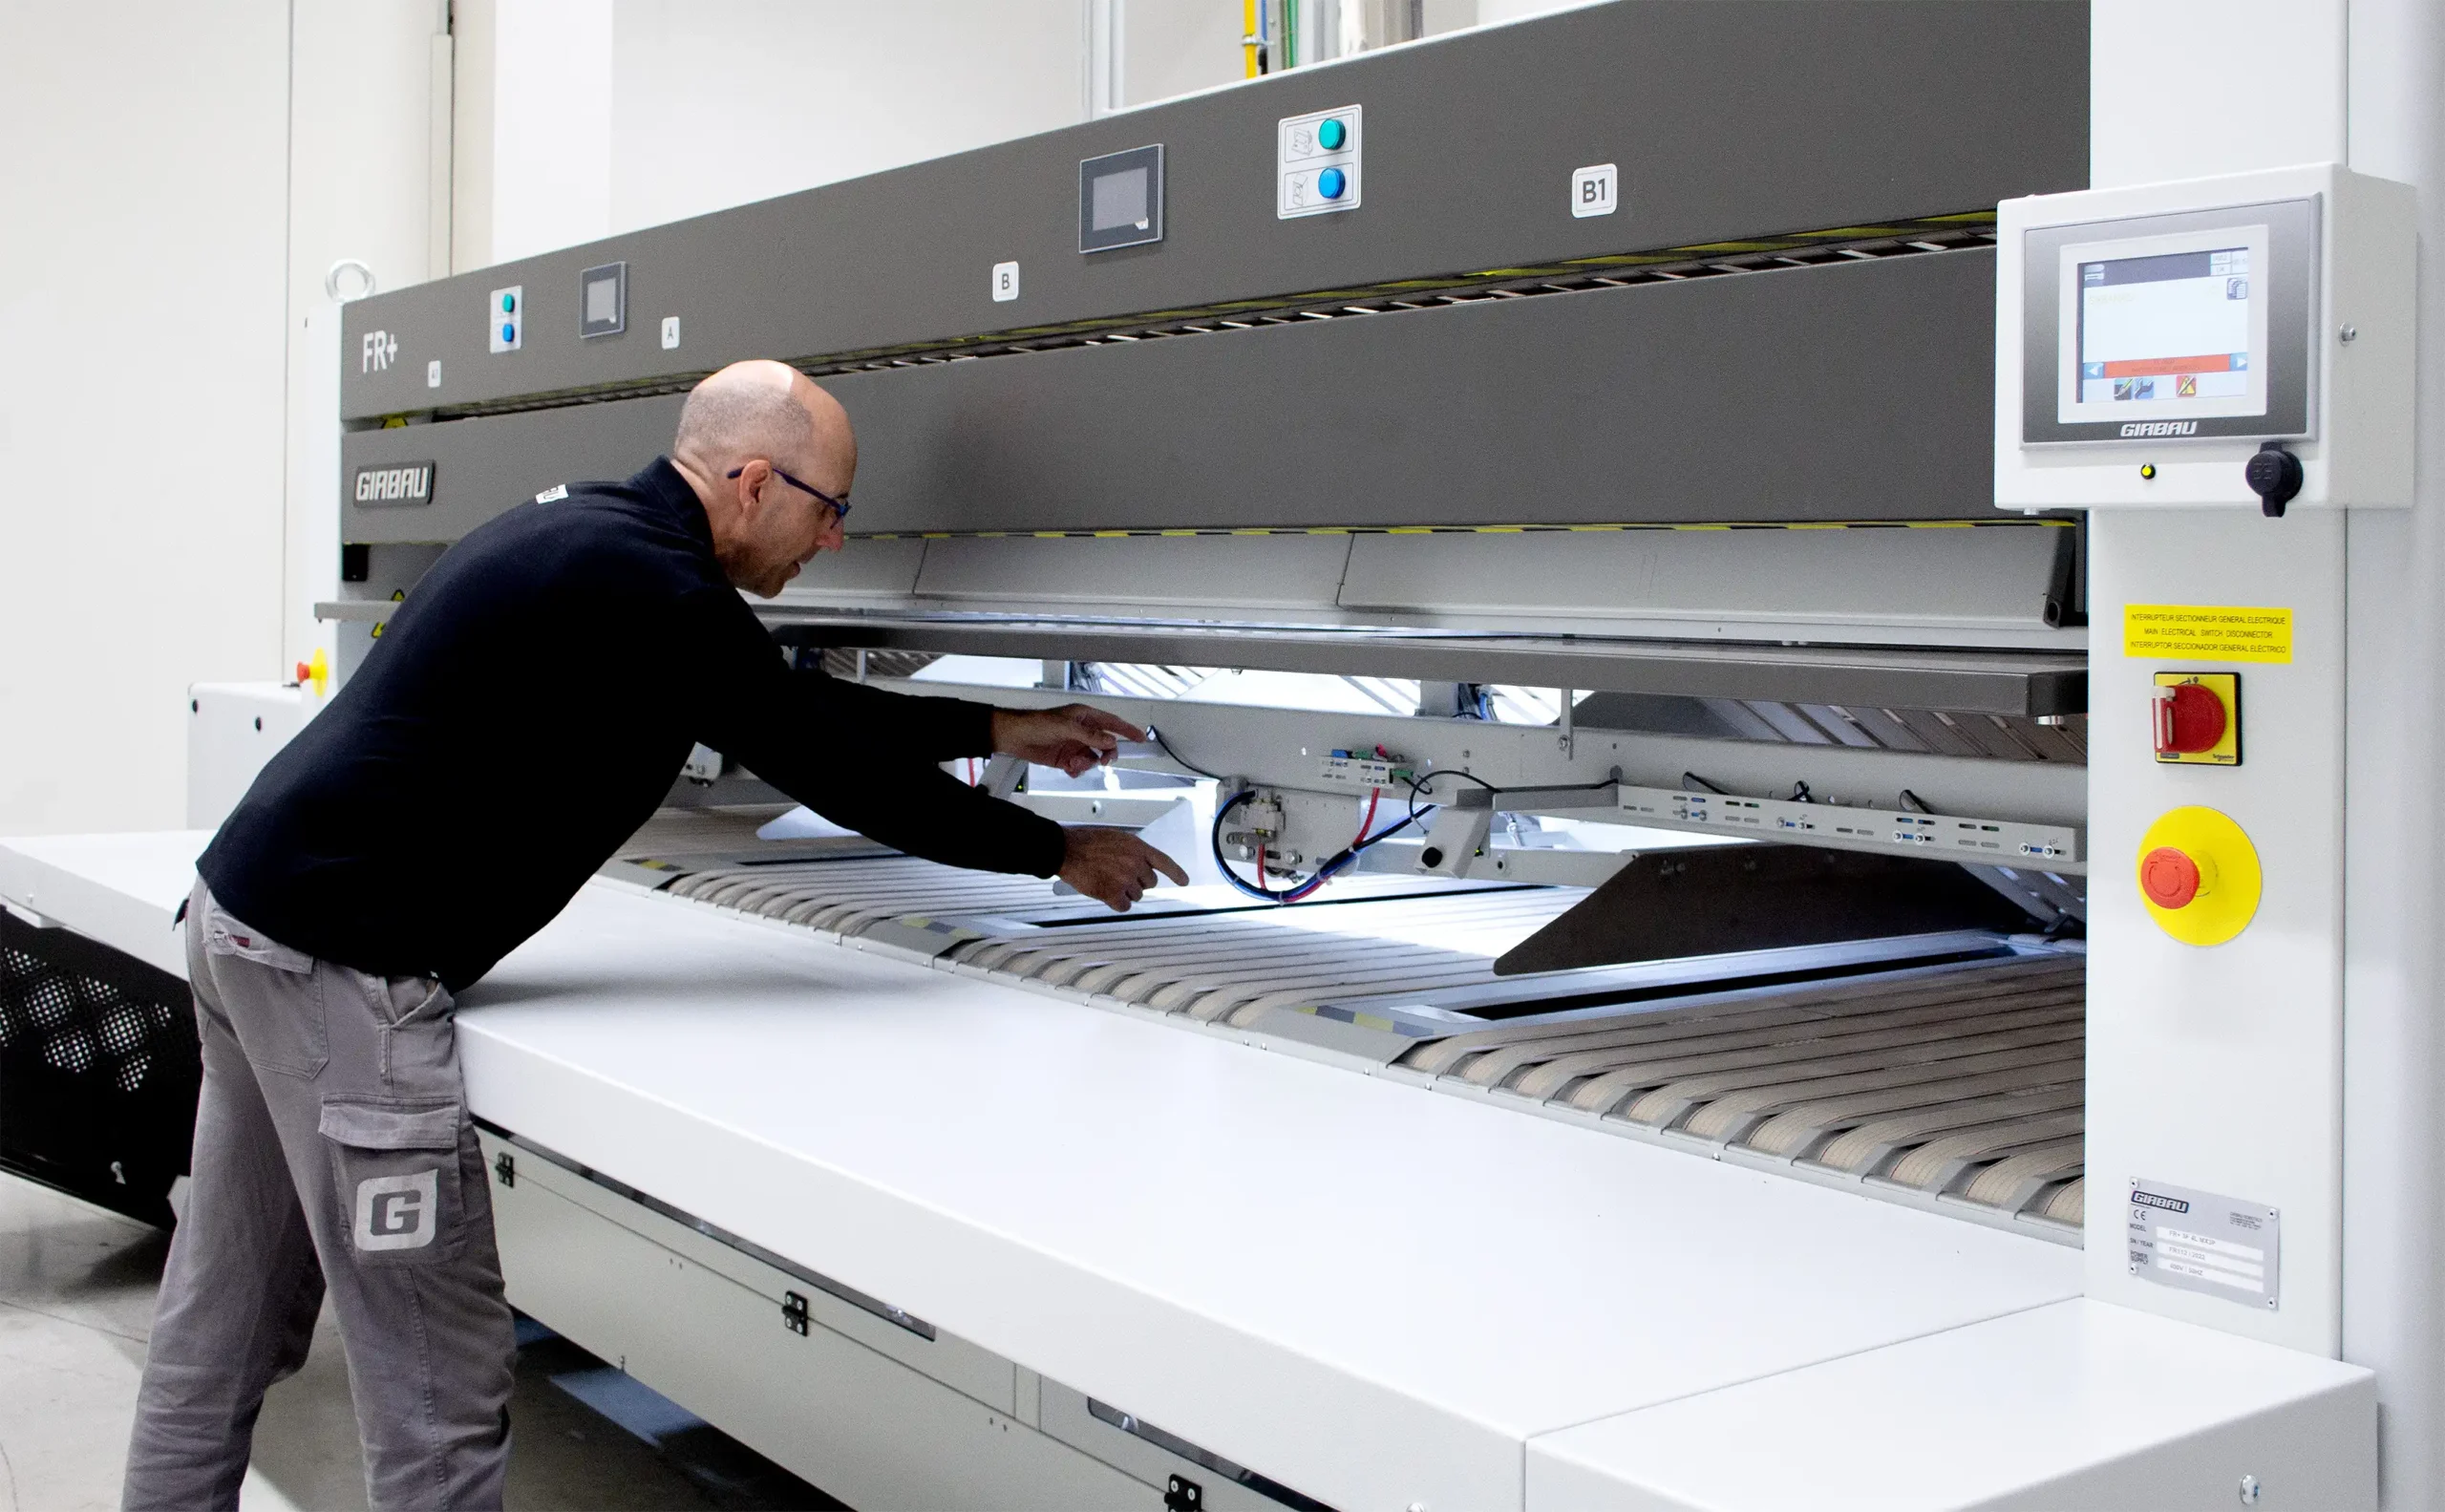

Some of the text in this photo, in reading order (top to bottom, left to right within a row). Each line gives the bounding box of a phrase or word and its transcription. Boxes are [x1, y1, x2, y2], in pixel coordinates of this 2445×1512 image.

[1583, 178, 1605, 203] B1
[1002, 273, 1010, 290] B
[667, 326, 674, 340] A
[363, 330, 398, 374] FR+
[2120, 420, 2198, 437] GIRBAU
[355, 466, 429, 501] GIRBAU
[2131, 613, 2286, 625] INTERRUPTEUR SECTIONNEUR GENERAL ELECTRIQUE
[2161, 628, 2197, 636] ELECTRICAL
[2200, 628, 2223, 637] SWITCH
[2226, 629, 2273, 638] DISCONNECTOR
[2130, 641, 2173, 650] INTERRUPTOR
[2174, 642, 2218, 651] SECCIONADOR
[2220, 644, 2249, 652] GENERAL
[2133, 1192, 2188, 1213] GIRBAU
[370, 1189, 421, 1236] G
[2133, 1209, 2146, 1221] CE
[2129, 1223, 2147, 1232] MODEL
